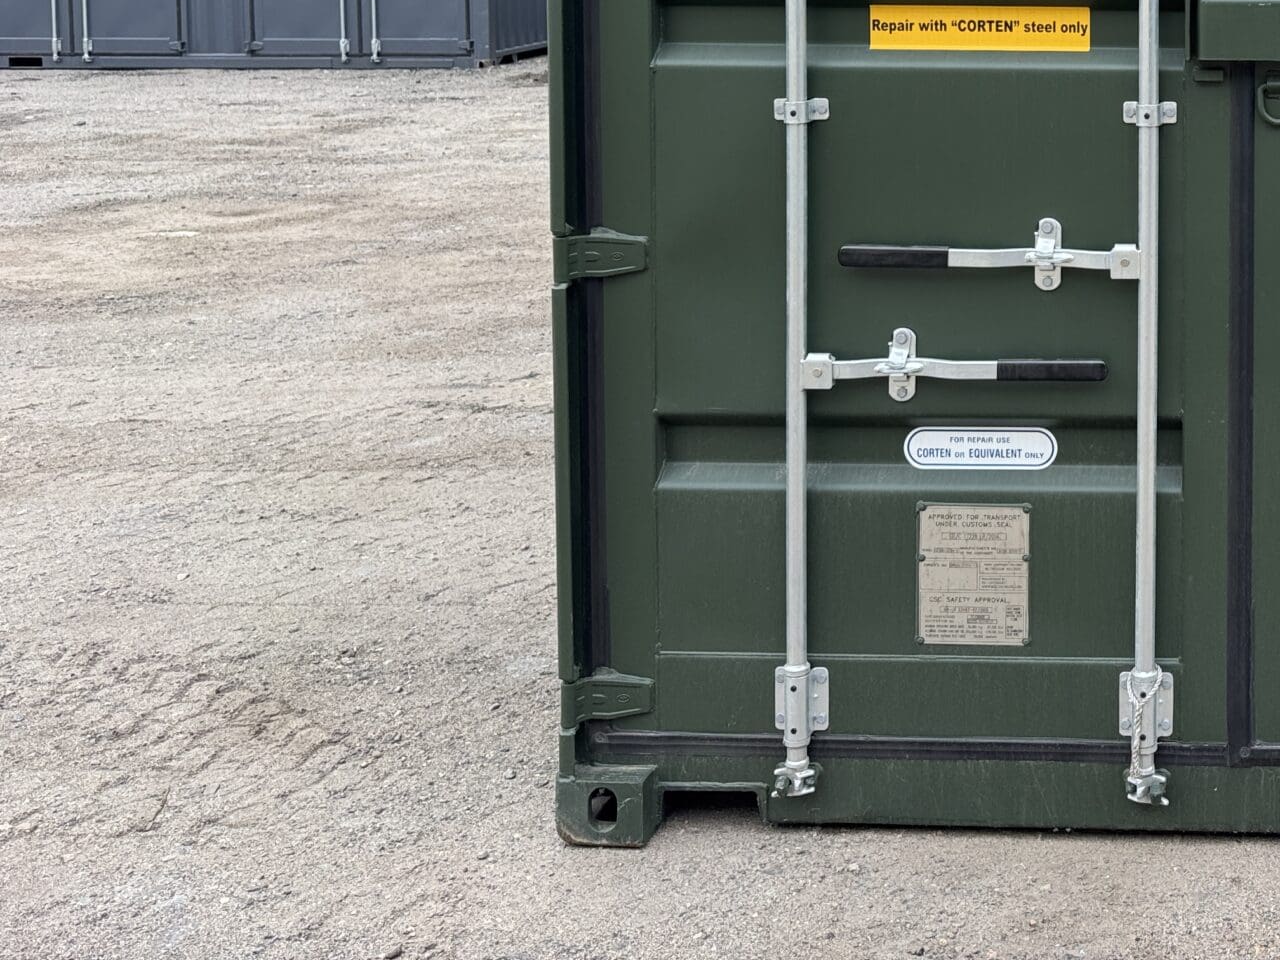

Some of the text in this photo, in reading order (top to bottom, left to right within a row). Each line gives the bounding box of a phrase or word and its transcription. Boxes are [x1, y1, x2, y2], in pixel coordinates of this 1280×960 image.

[871, 18, 914, 35] Repair
[918, 19, 948, 32] with
[1023, 20, 1057, 33] steel
[1060, 20, 1088, 37] only
[949, 436, 1011, 444] FOR REPAIR USE
[916, 448, 952, 458] CORTEN
[968, 448, 1023, 459] EQUIVALENT
[1024, 451, 1045, 459] ONLY
